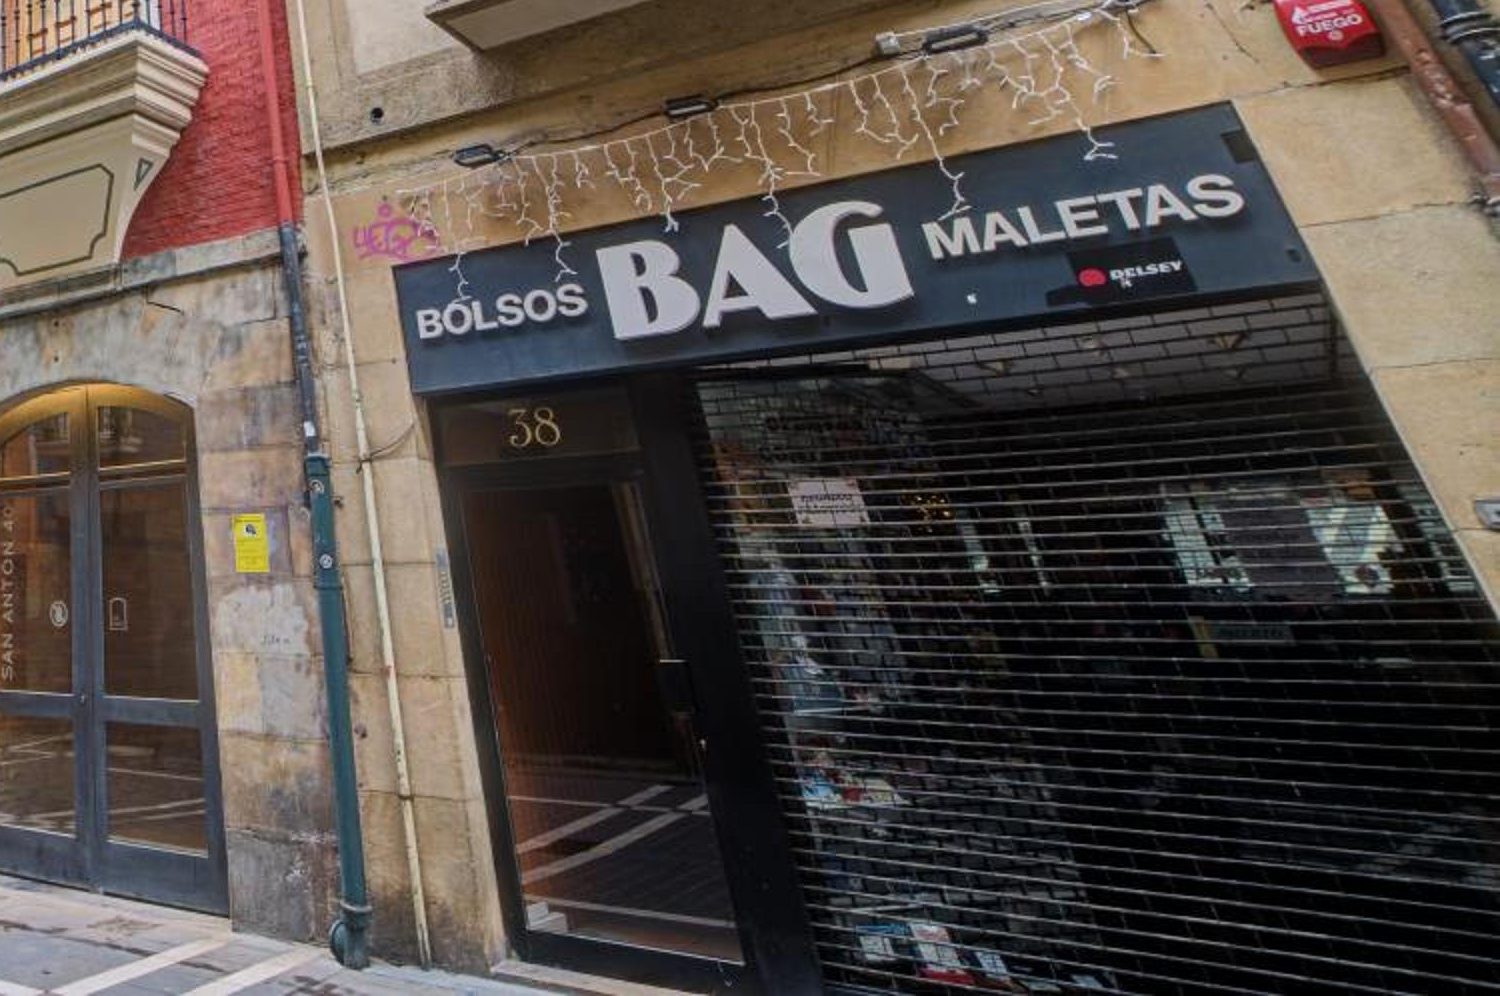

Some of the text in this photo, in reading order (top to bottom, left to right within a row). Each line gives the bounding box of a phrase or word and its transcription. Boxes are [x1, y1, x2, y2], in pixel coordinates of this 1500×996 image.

[1295, 12, 1364, 37] FUEGO
[417, 173, 1246, 340] BOLSOS BAG MALETAS
[1108, 260, 1183, 281] DELSEY
[508, 406, 562, 449] 38
[2, 504, 15, 532] 40
[1, 633, 15, 681] SAN
